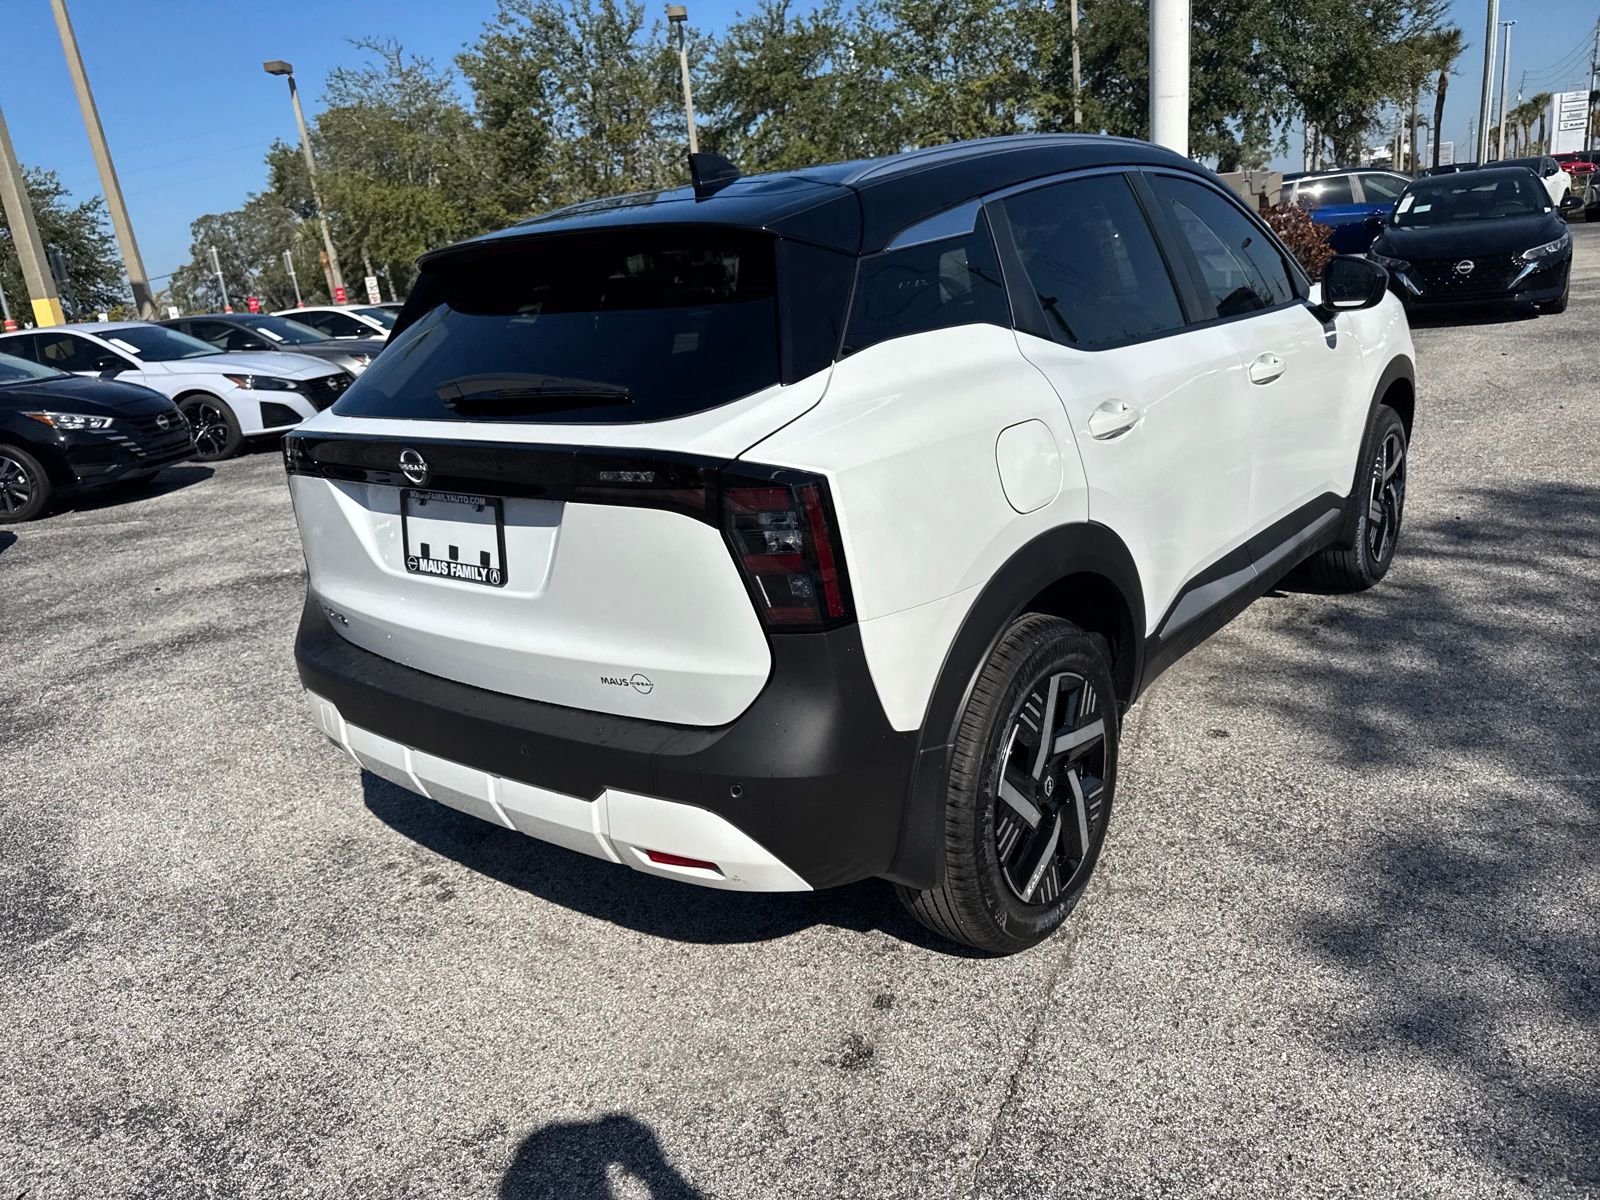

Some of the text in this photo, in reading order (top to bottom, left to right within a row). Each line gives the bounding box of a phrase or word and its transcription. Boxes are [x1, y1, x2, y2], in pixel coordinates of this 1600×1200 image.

[419, 558, 488, 582] MAUS FAMILY
[600, 676, 629, 687] MAUS
